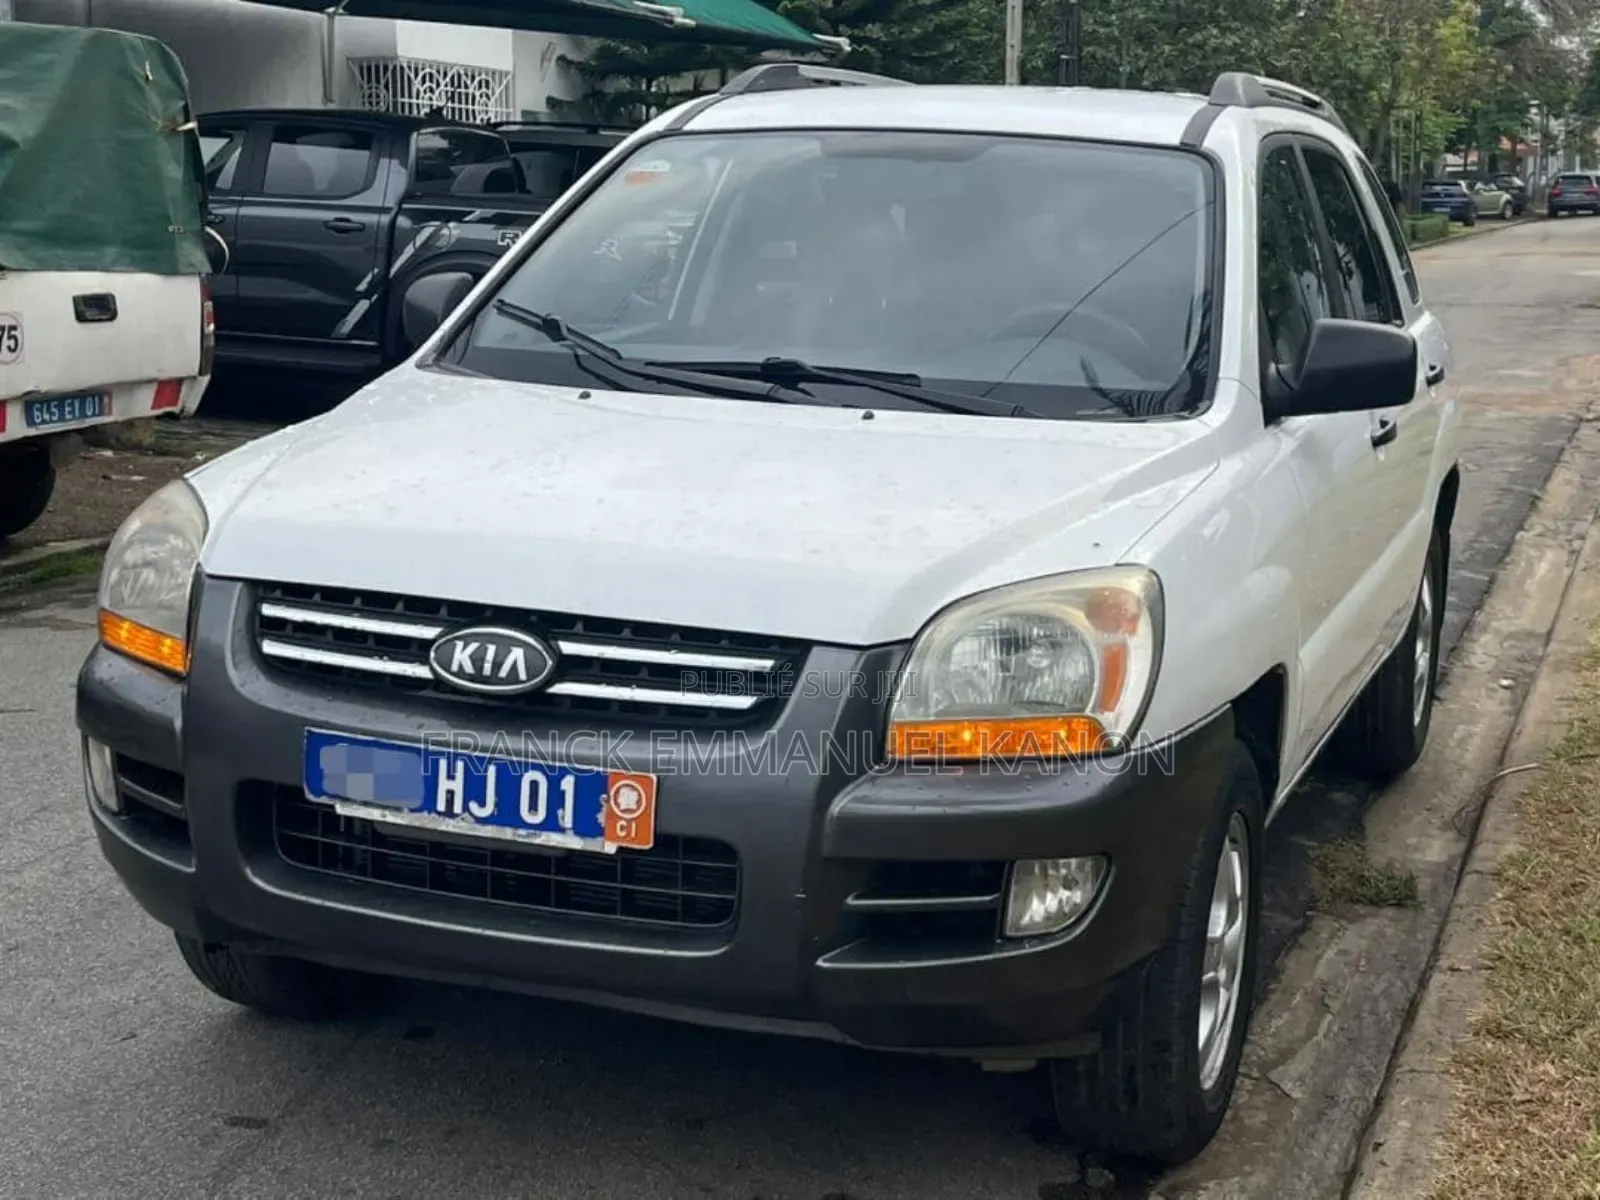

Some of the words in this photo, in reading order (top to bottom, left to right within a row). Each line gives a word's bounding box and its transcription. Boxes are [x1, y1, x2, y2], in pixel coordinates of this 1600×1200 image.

[33, 400, 59, 423] 645
[85, 394, 99, 416] 01
[450, 640, 528, 681] KIA
[436, 758, 497, 818] HJ
[519, 770, 576, 829] 01
[616, 820, 637, 838] CI
